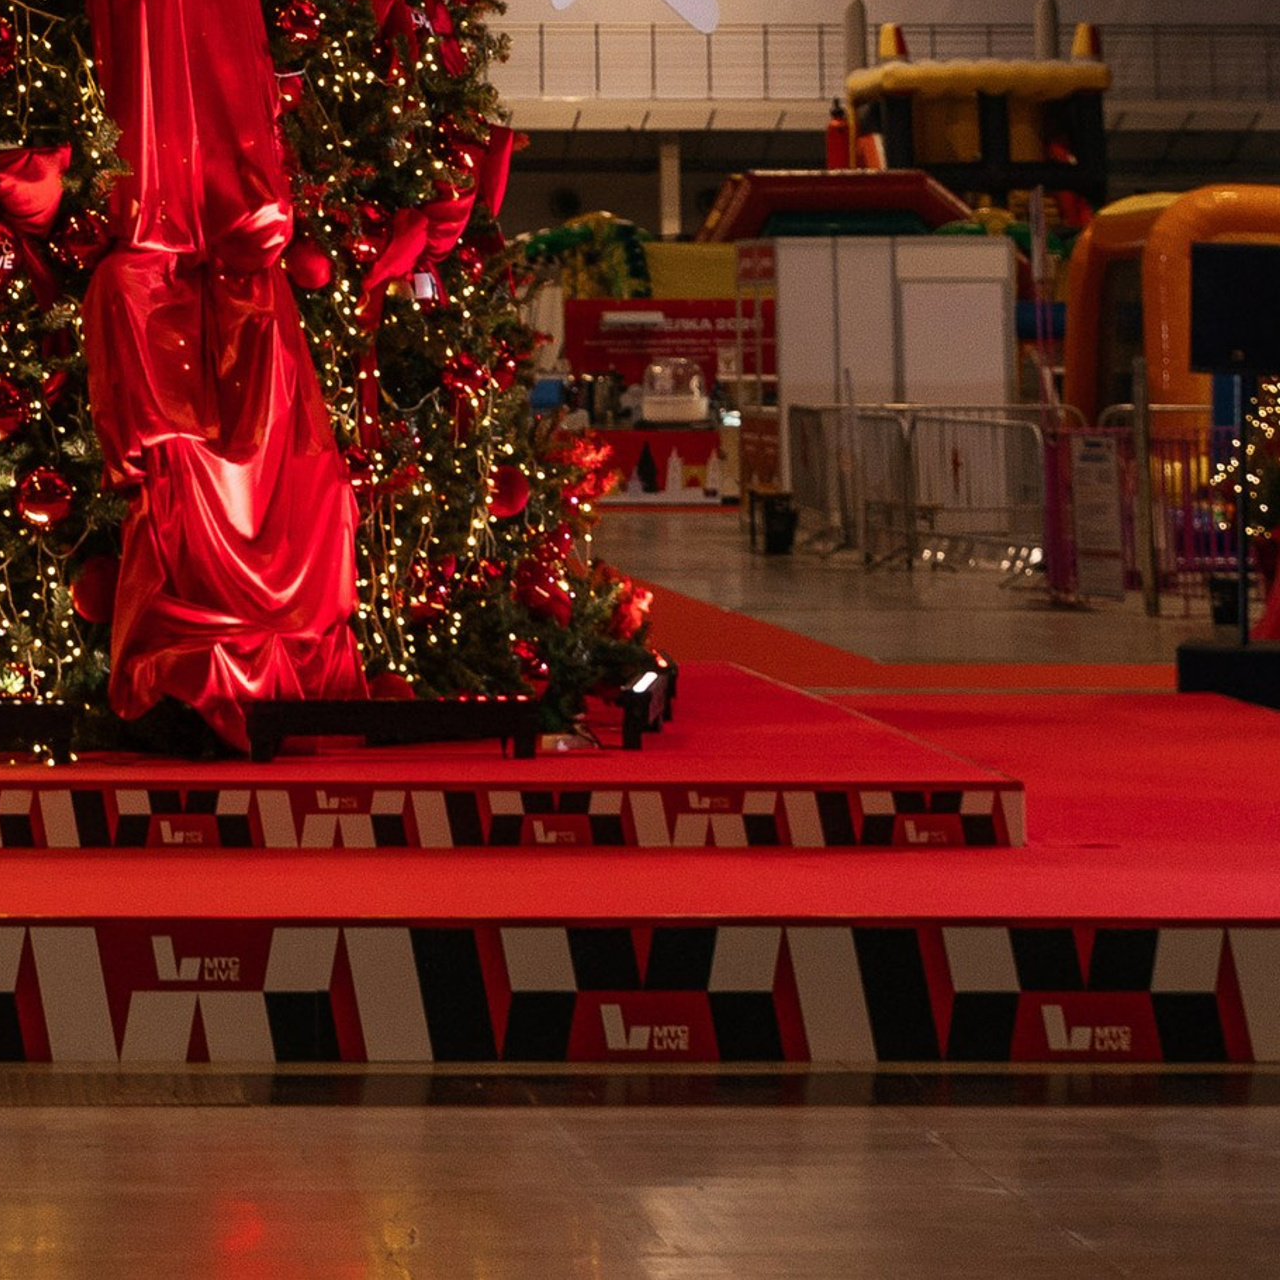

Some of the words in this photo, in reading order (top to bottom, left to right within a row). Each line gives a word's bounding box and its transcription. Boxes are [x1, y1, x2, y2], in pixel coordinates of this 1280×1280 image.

[204, 968, 240, 980] LIVE
[653, 1037, 689, 1049] LIVE
[1095, 1038, 1131, 1050] LIVE
